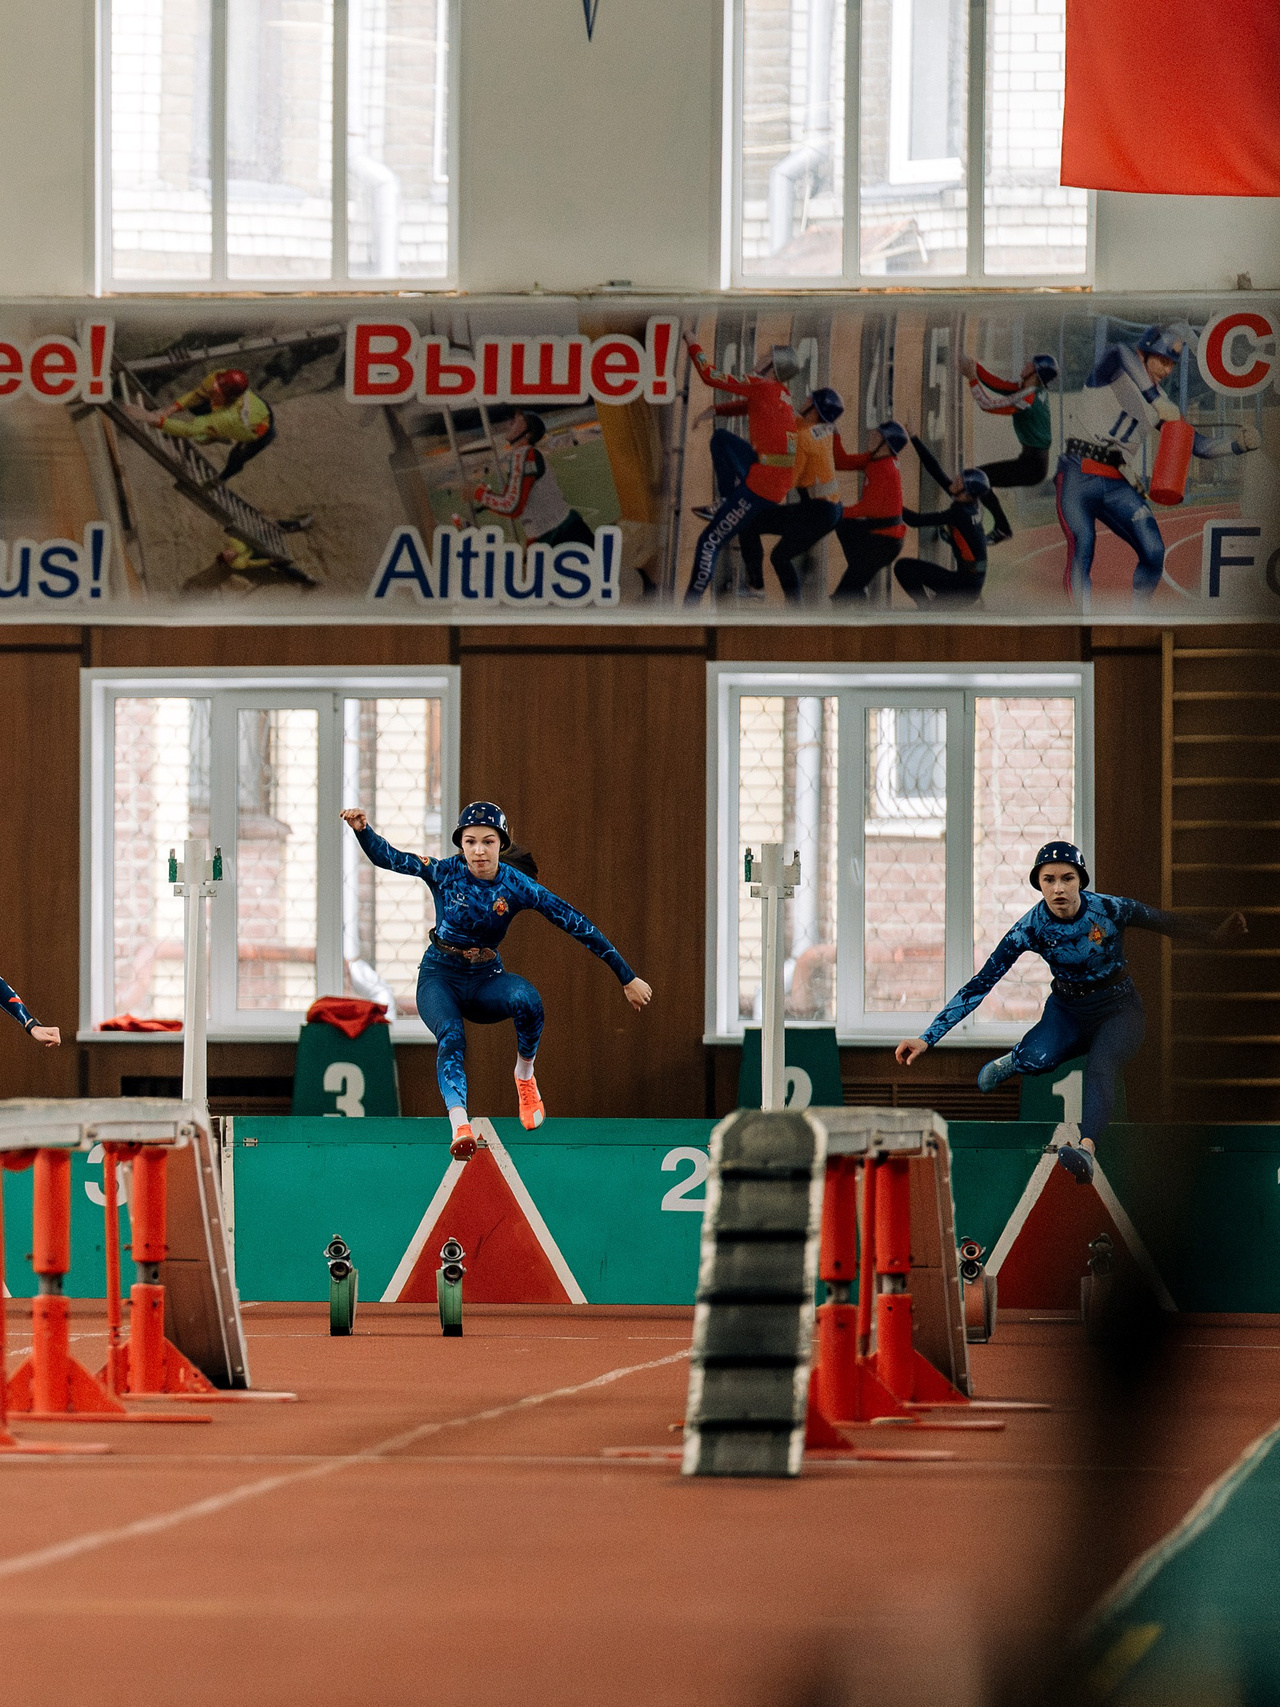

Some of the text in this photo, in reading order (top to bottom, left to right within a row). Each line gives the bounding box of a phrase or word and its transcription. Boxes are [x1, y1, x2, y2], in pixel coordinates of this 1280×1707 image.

[353, 323, 671, 397] Выше!
[374, 533, 614, 599] Altius!
[694, 498, 752, 592] ПОДМОСКОВЬЕ
[323, 1061, 365, 1118] 3
[1052, 1070, 1083, 1123] 1
[661, 1146, 709, 1212] 2
